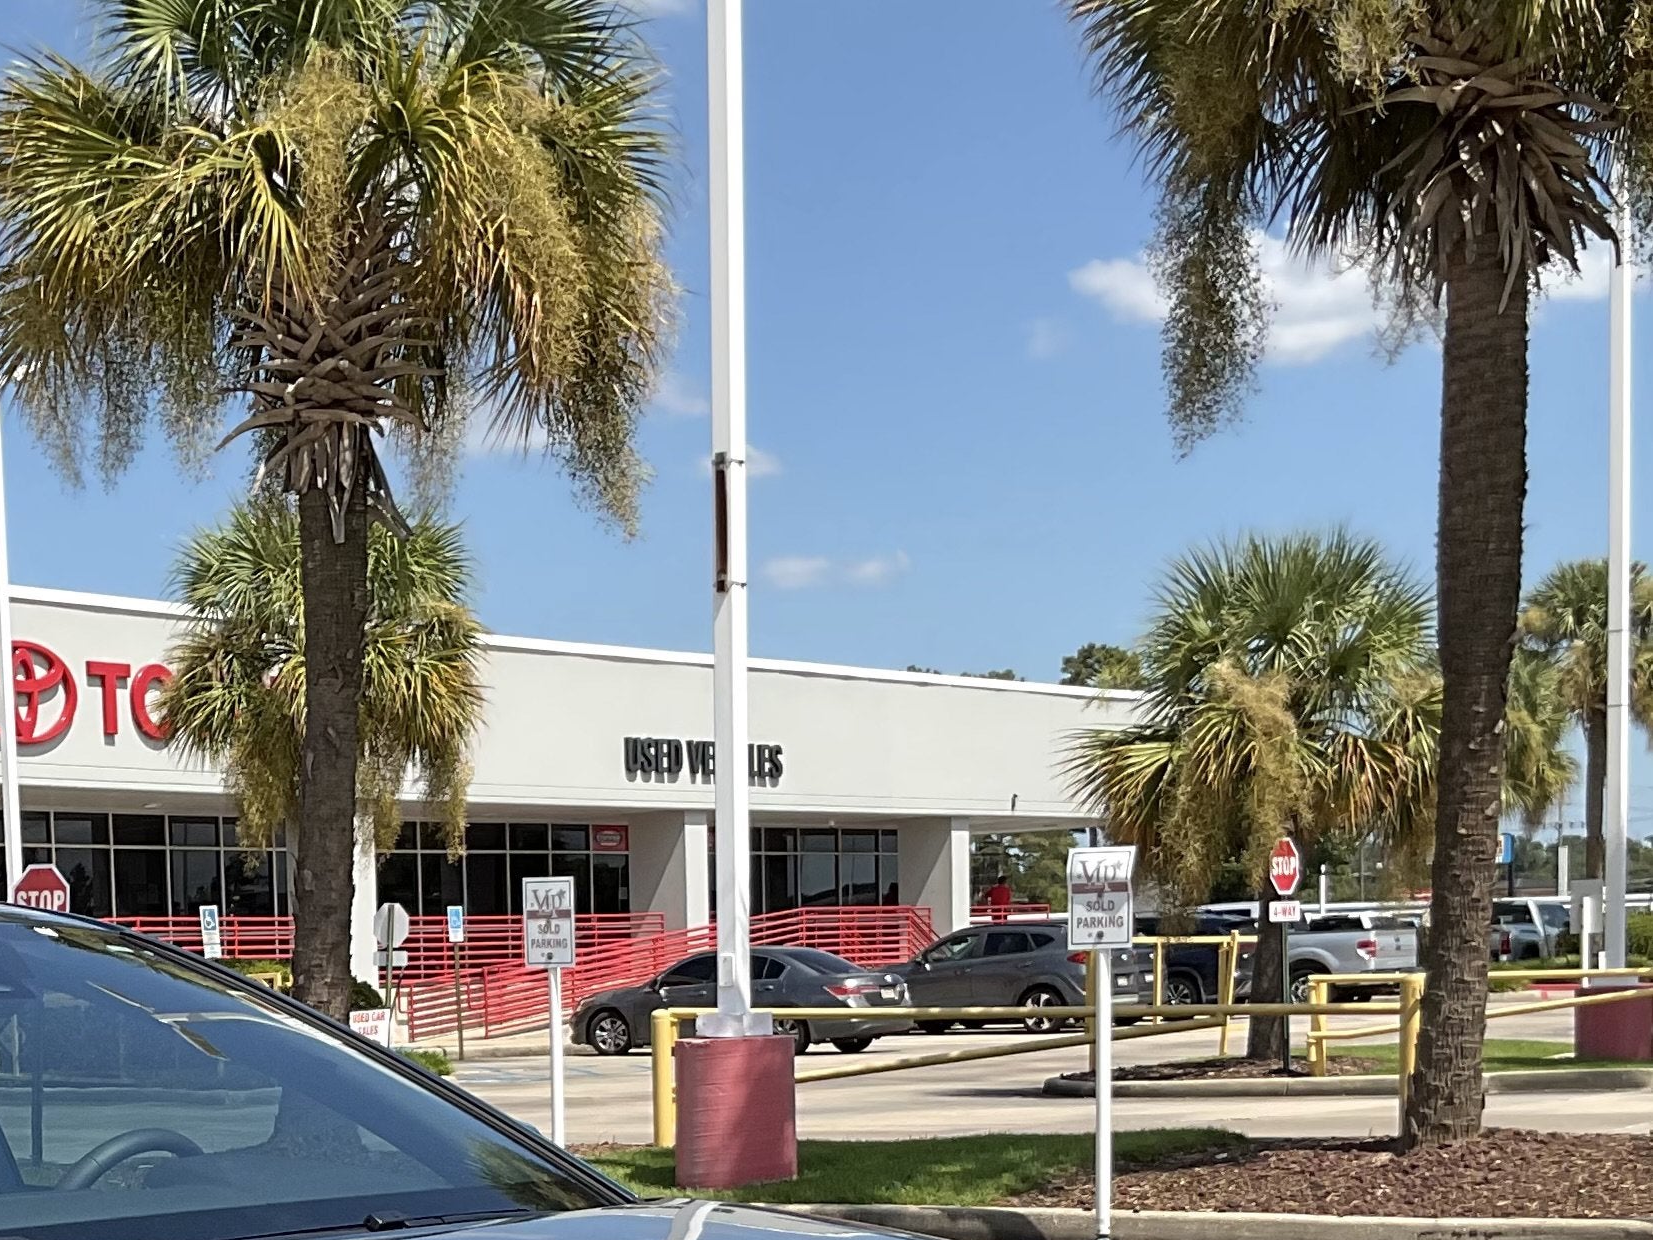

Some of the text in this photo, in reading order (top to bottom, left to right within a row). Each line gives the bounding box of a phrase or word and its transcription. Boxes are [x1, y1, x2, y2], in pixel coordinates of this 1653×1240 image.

[623, 737, 783, 779] USED VELES
[1272, 856, 1296, 875] STOP
[17, 890, 65, 910] STOP
[1086, 900, 1115, 912] SOLD
[1273, 905, 1296, 917] 4-WAY
[1076, 916, 1124, 928] PARKING
[538, 923, 560, 934] SOLD
[531, 938, 568, 949] PARKING
[353, 1011, 385, 1023] USED CAR
